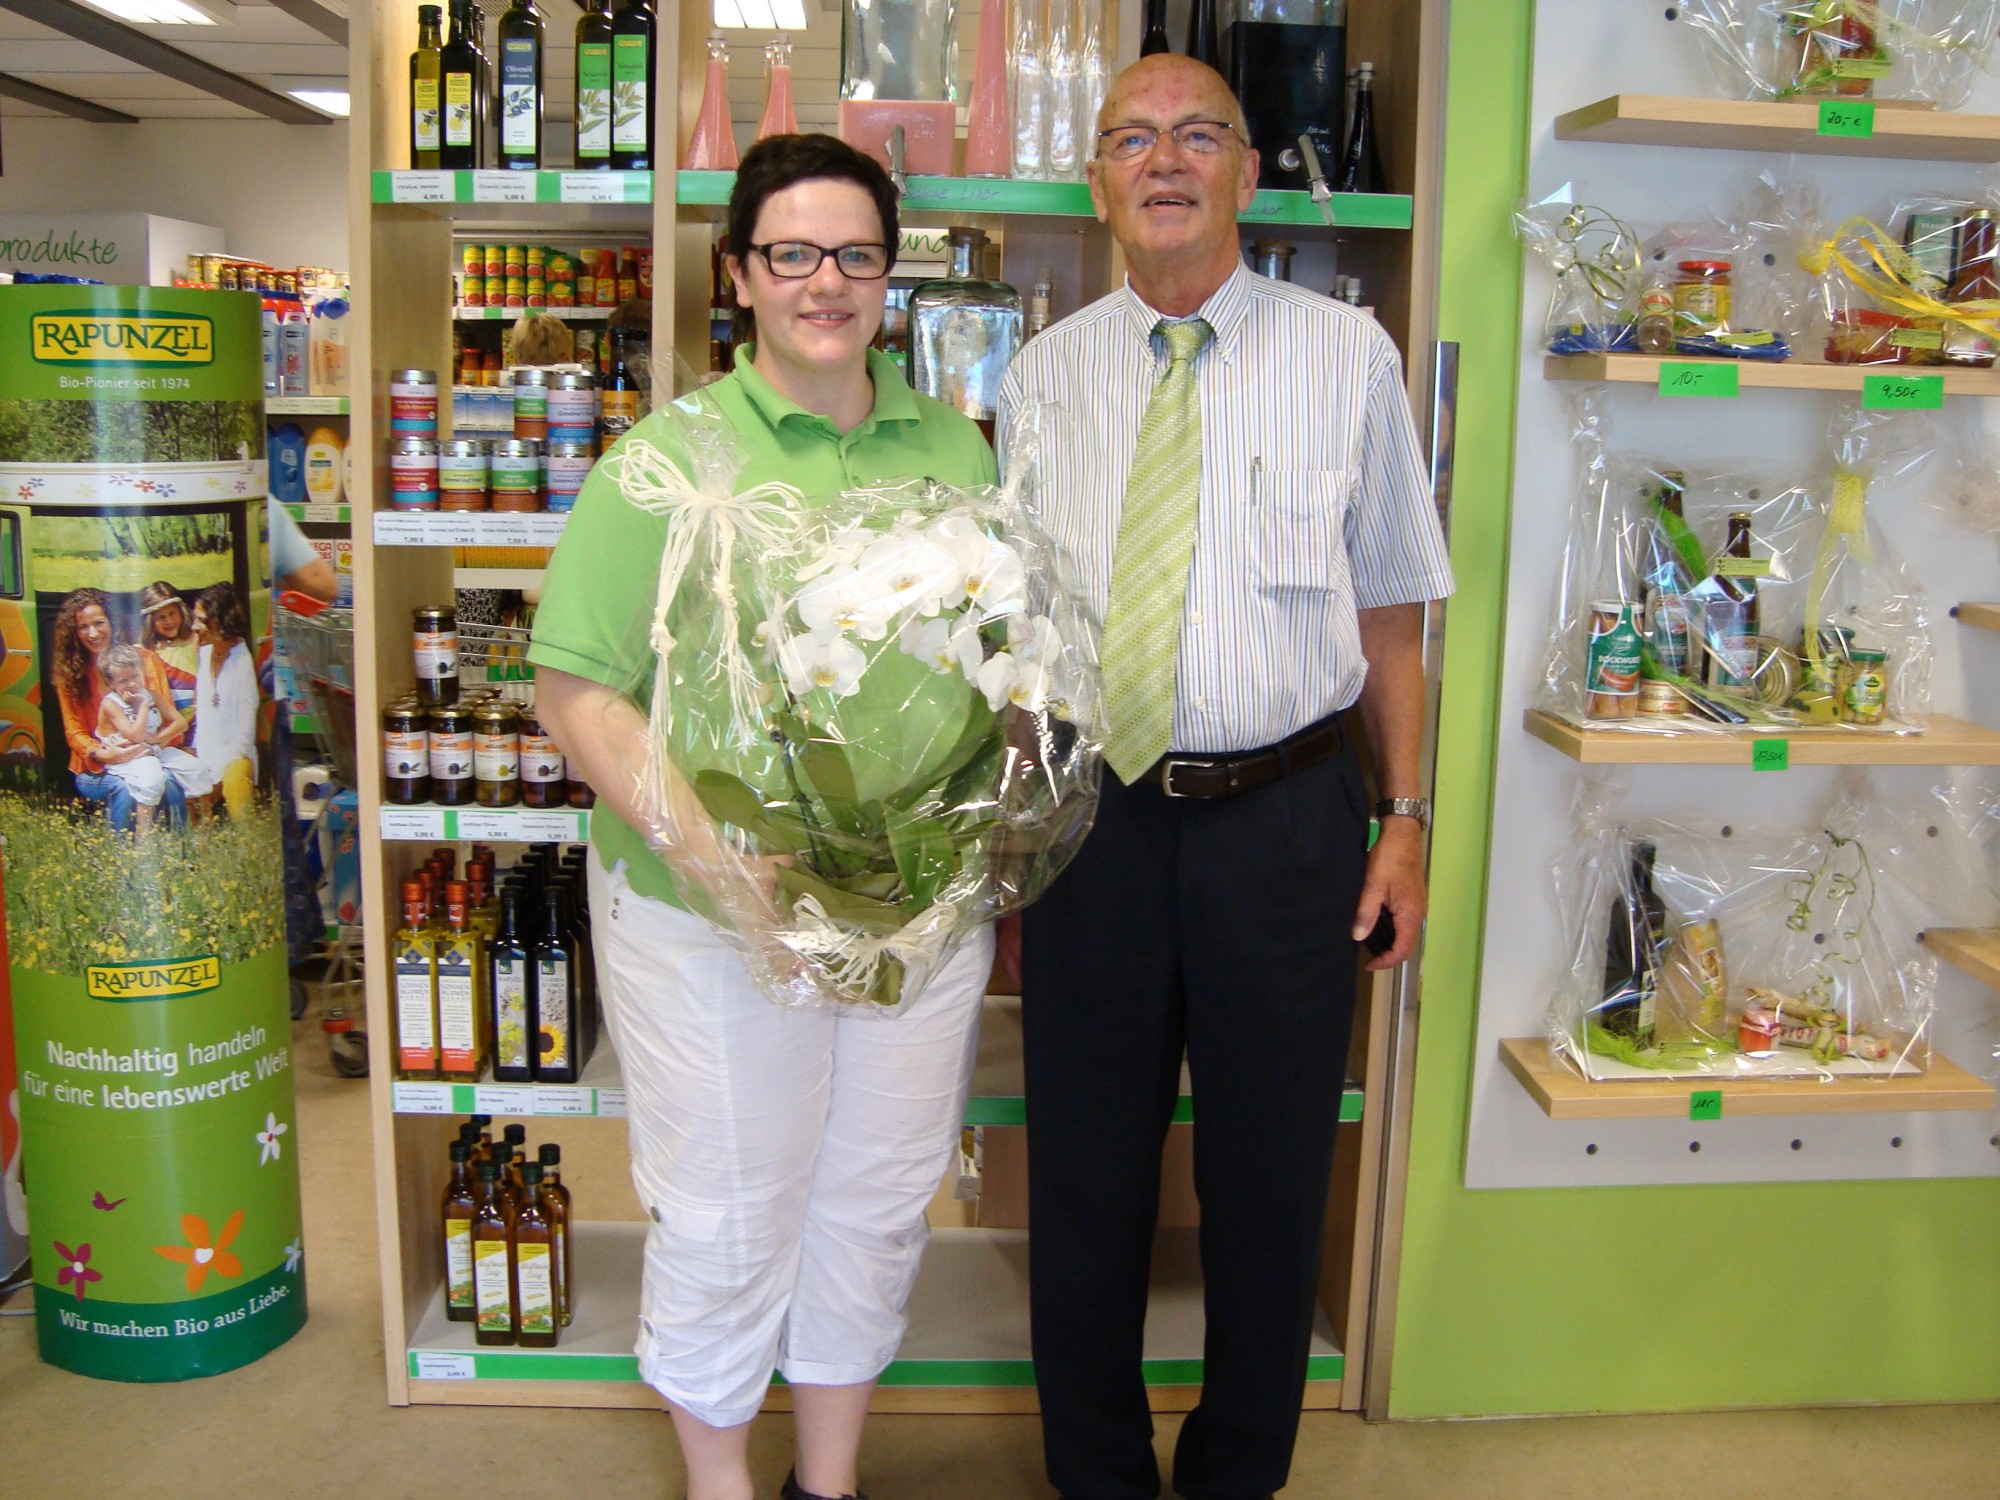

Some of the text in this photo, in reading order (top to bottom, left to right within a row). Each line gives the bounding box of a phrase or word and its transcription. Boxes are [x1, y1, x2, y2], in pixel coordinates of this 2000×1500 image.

[38, 323, 209, 357] RAPUNZEL
[60, 376, 190, 389] Bio-Pionier seit 1974
[91, 962, 218, 995] RAPUNZEL
[46, 1025, 266, 1078] Nachhaltig handeln
[23, 1047, 288, 1110] für eine lebenswerte Welt
[58, 1283, 291, 1338] Wir machen Bio aus Liebe.
